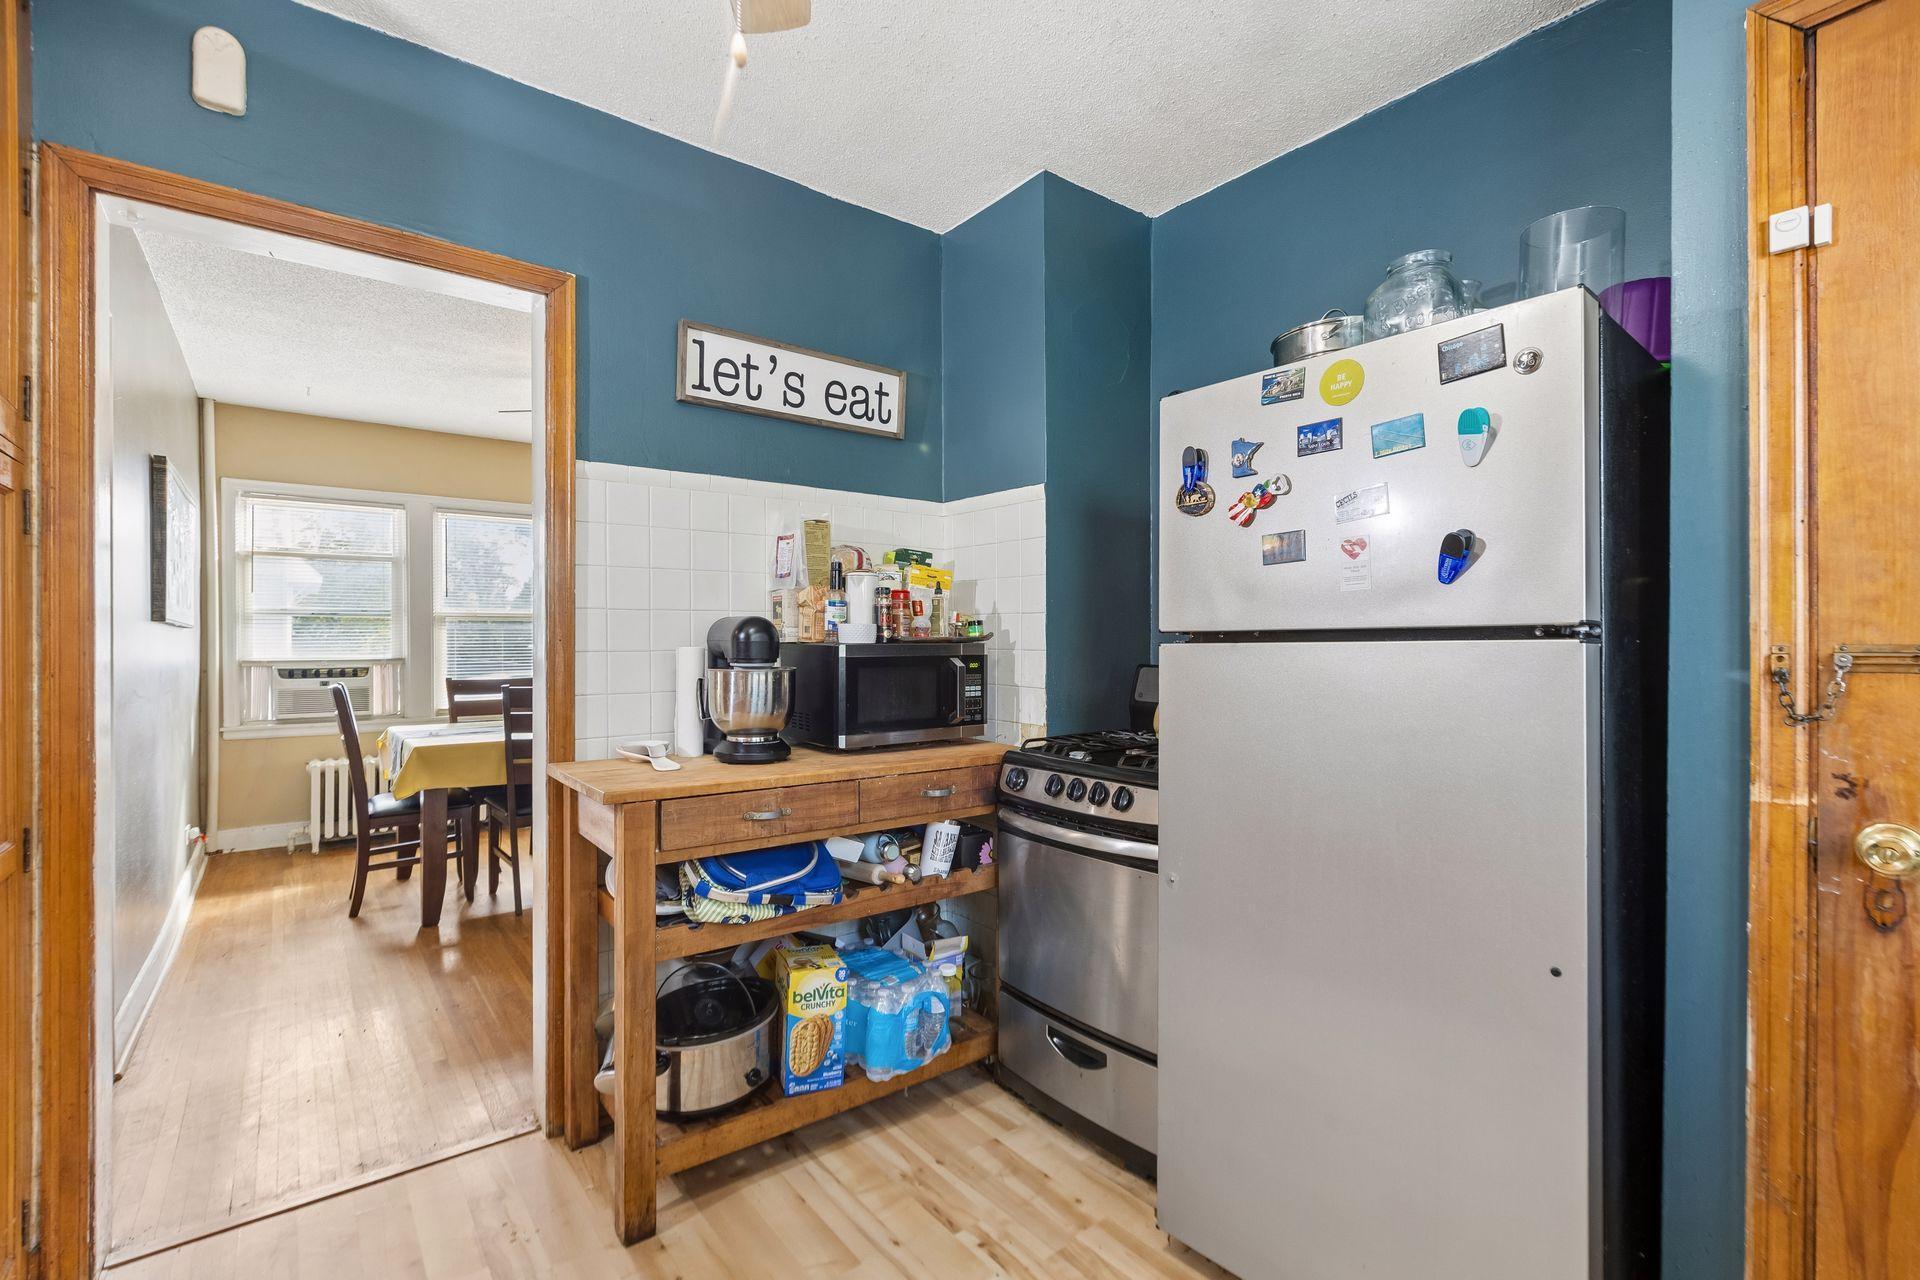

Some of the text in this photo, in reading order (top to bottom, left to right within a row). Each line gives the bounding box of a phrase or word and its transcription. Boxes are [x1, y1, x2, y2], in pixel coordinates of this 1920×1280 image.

[1441, 341, 1464, 352] Chicago
[691, 338, 892, 425] let's eat
[1337, 373, 1346, 381] BE
[1330, 380, 1353, 391] HAPPY
[792, 982, 845, 1004] belVita
[800, 1000, 836, 1011] CRUNCHY
[845, 1018, 858, 1027] ter
